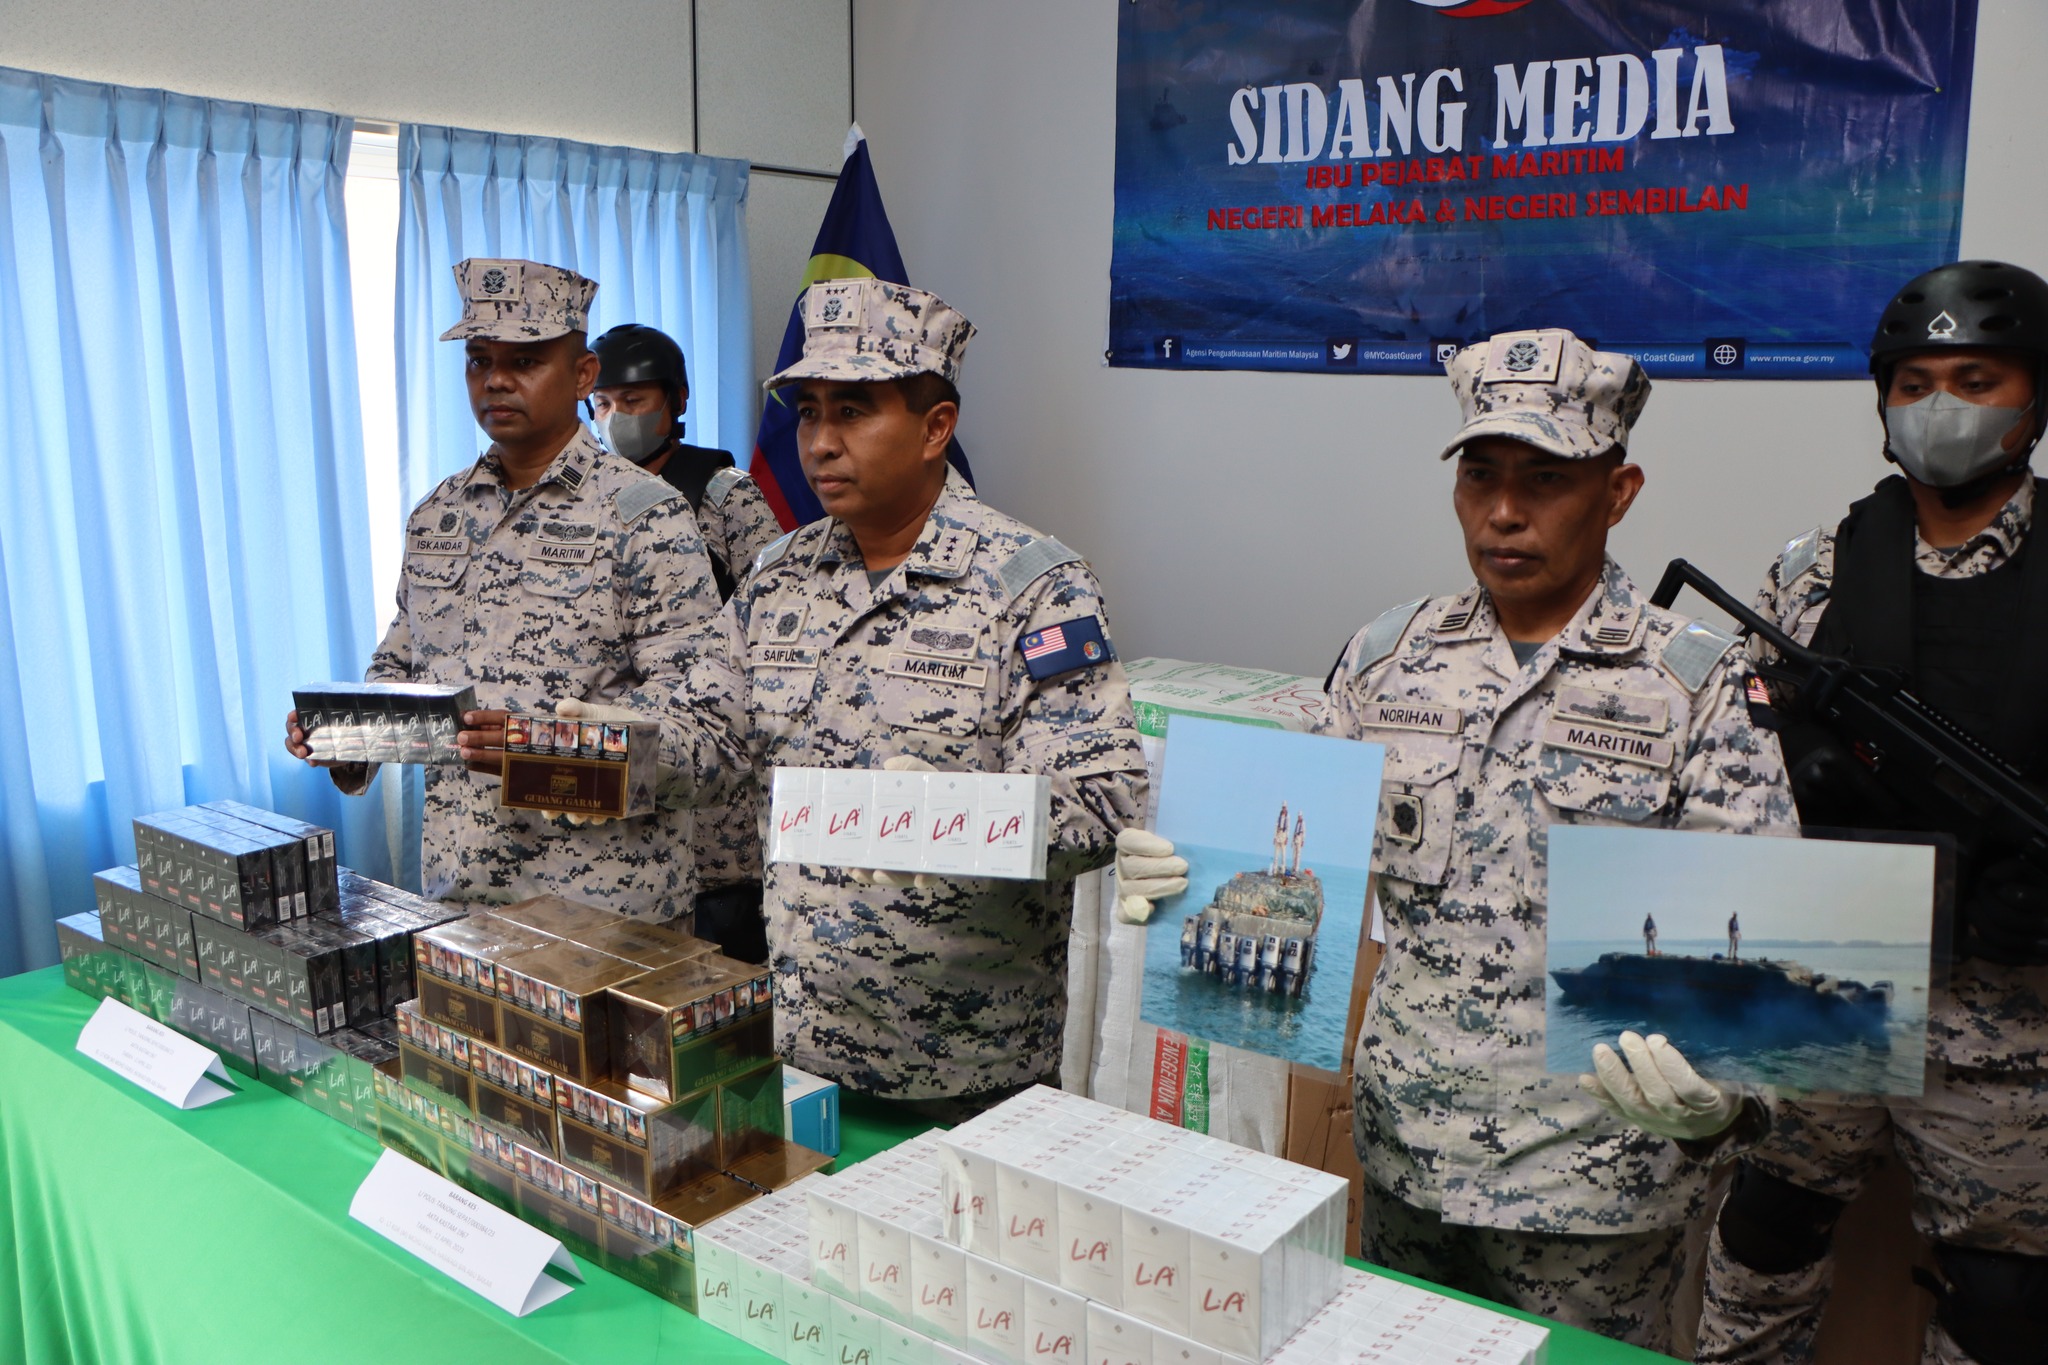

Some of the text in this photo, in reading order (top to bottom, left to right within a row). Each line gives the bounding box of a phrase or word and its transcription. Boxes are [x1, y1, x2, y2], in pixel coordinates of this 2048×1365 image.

[1227, 44, 1735, 166] SIDANG MEDIA
[1306, 147, 1625, 190] IBU PEJABAT MARITIM
[1207, 183, 1749, 231] NEGERI MELAKA & NEGERI SEMBILAN
[1186, 348, 1319, 361] Agensi Penguatkuasaan Maritim Malaysia
[1363, 350, 1422, 361] @MYCoastGuard
[1643, 352, 1667, 363] Coast
[1669, 352, 1694, 363] Guard
[1750, 354, 1834, 365] www.mmea.gov.my
[417, 540, 463, 551] ISKANDAR
[541, 546, 585, 559] MARITIM
[763, 649, 797, 663] SAIFUL
[904, 659, 967, 680] MARITIM
[1378, 708, 1443, 727] NORIHAN
[1567, 728, 1652, 757] MARITIM
[525, 794, 601, 809] GUDANG GARAM
[1157, 1034, 1181, 1107] ENGGEMUK
[448, 1191, 469, 1206] BARANG
